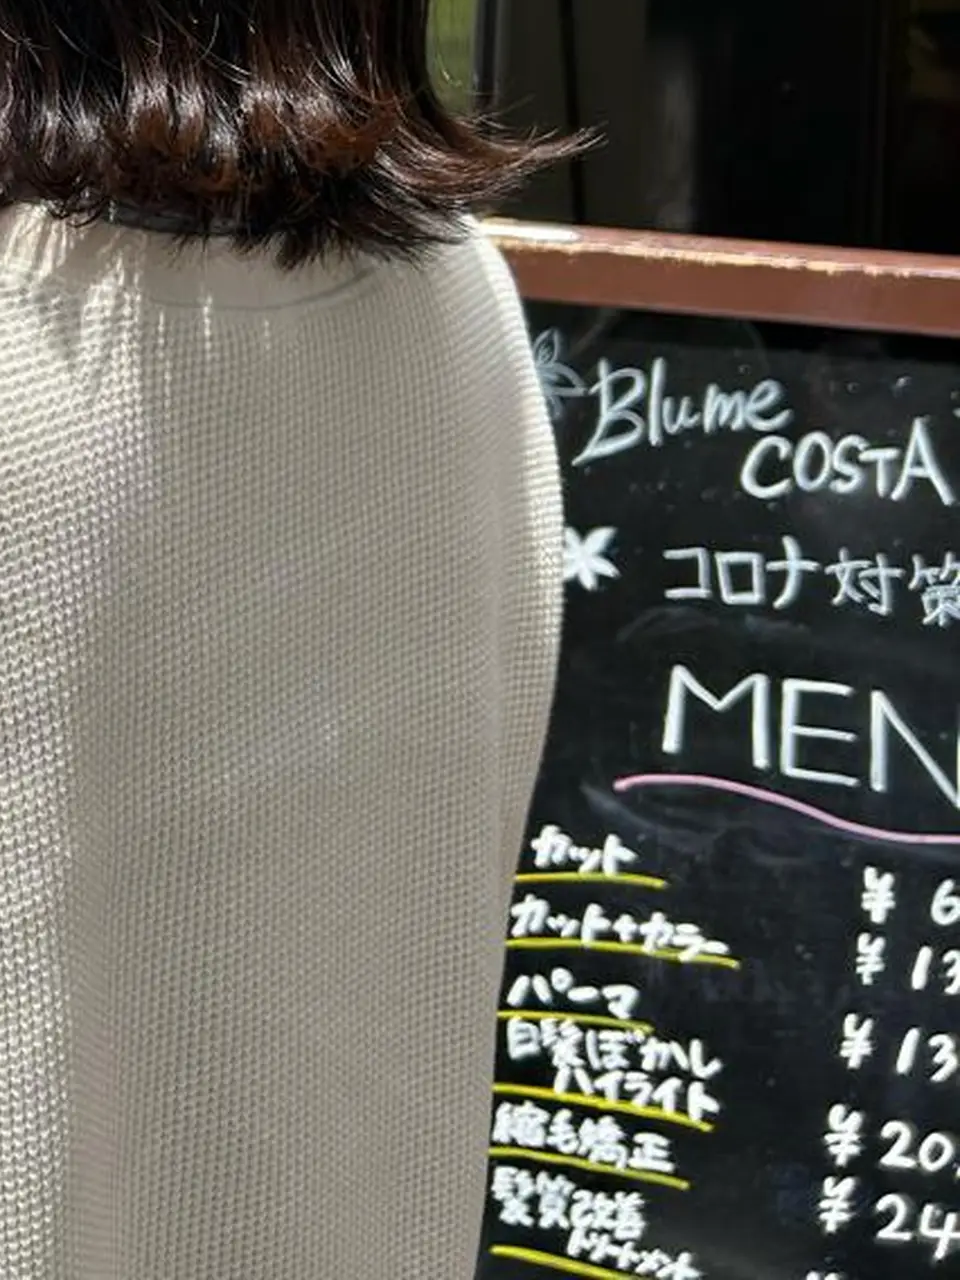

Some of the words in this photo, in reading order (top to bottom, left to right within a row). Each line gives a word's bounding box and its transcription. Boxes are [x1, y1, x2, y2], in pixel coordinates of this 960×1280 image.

[571, 357, 794, 465] Blume
[741, 417, 955, 506] COSTA
[530, 824, 638, 877] カット
[506, 966, 640, 1019] パーマ
[553, 1066, 722, 1121] ハイライト
